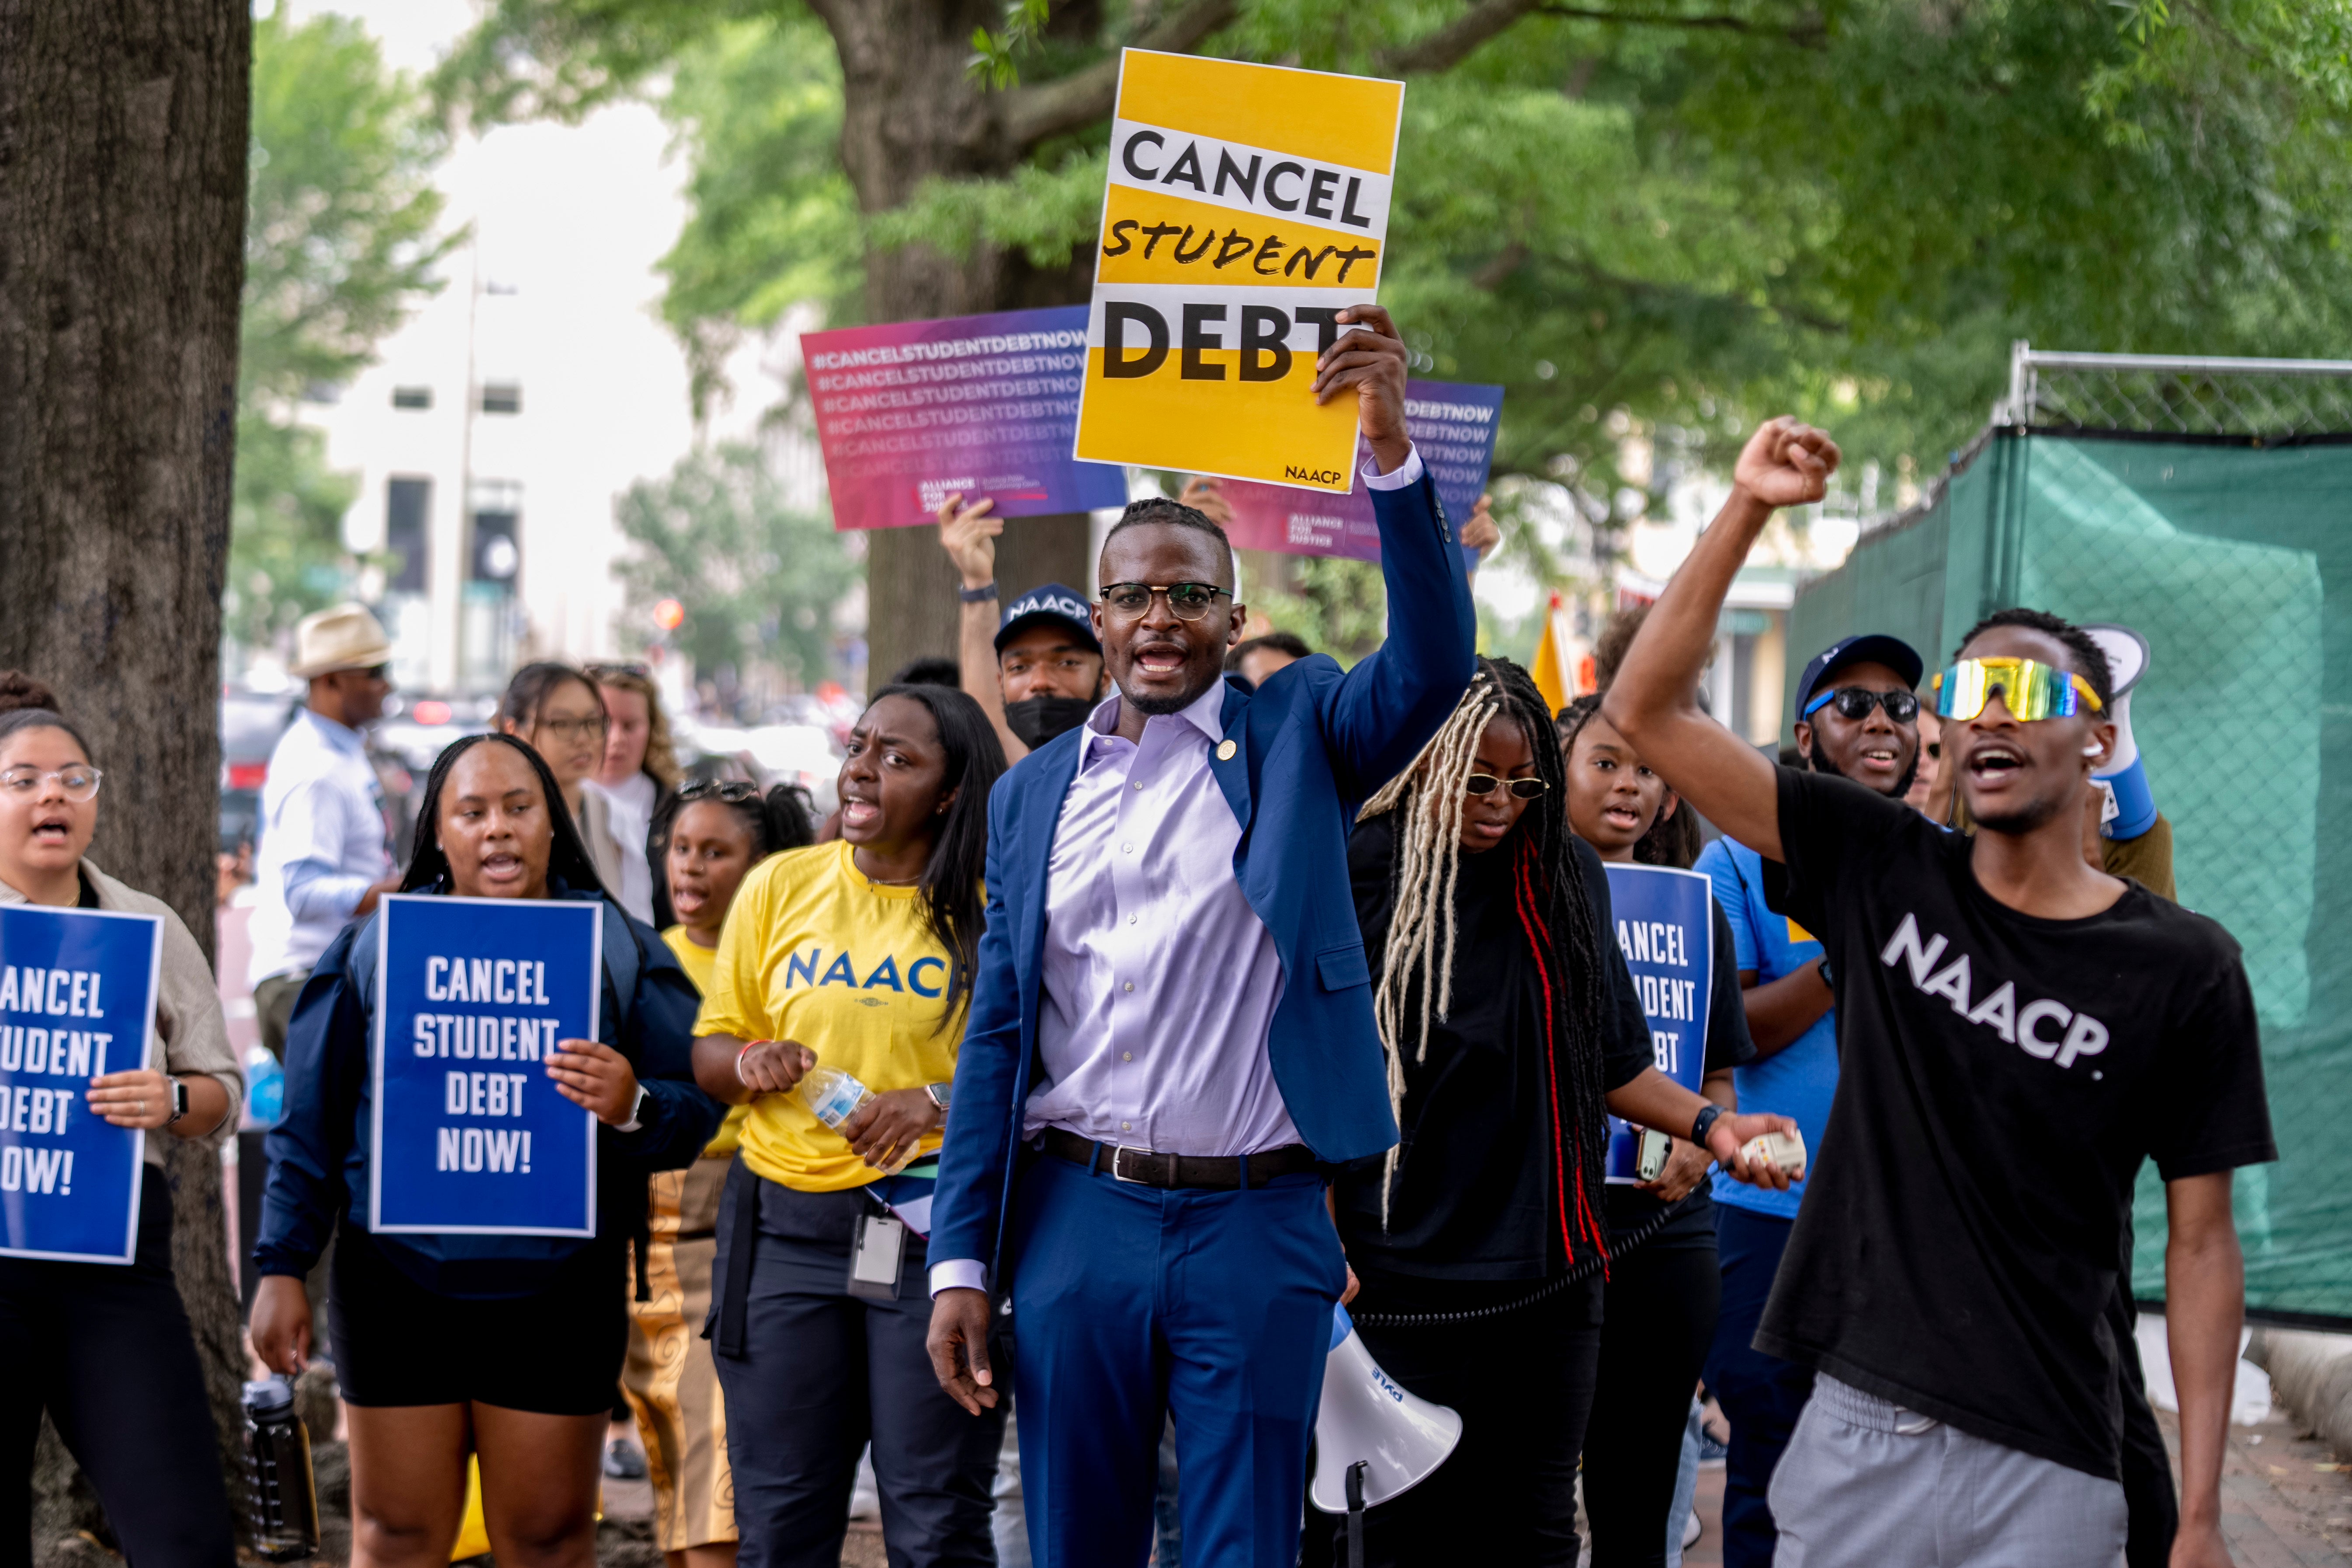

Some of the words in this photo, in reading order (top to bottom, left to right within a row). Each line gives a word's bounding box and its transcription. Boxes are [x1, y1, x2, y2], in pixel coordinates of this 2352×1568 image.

[1123, 131, 1371, 229] CANCEL
[1103, 219, 1376, 283] STUDENT
[1103, 301, 1361, 382] DEBT
[822, 375, 1082, 413] #CANCELSTUDENTDEBTNO
[919, 476, 975, 492] ALLIANCE
[1286, 464, 1341, 485] NAACP
[1009, 594, 1088, 621] NAACP
[426, 956, 549, 1005] CANCEL
[1880, 912, 2109, 1069] NAACP
[0, 1024, 113, 1077] UDENT
[413, 1013, 559, 1061] STUDENT
[445, 1071, 527, 1117] DEBT
[436, 1128, 531, 1174] NOW!
[1372, 1367, 1403, 1403] PYLE
